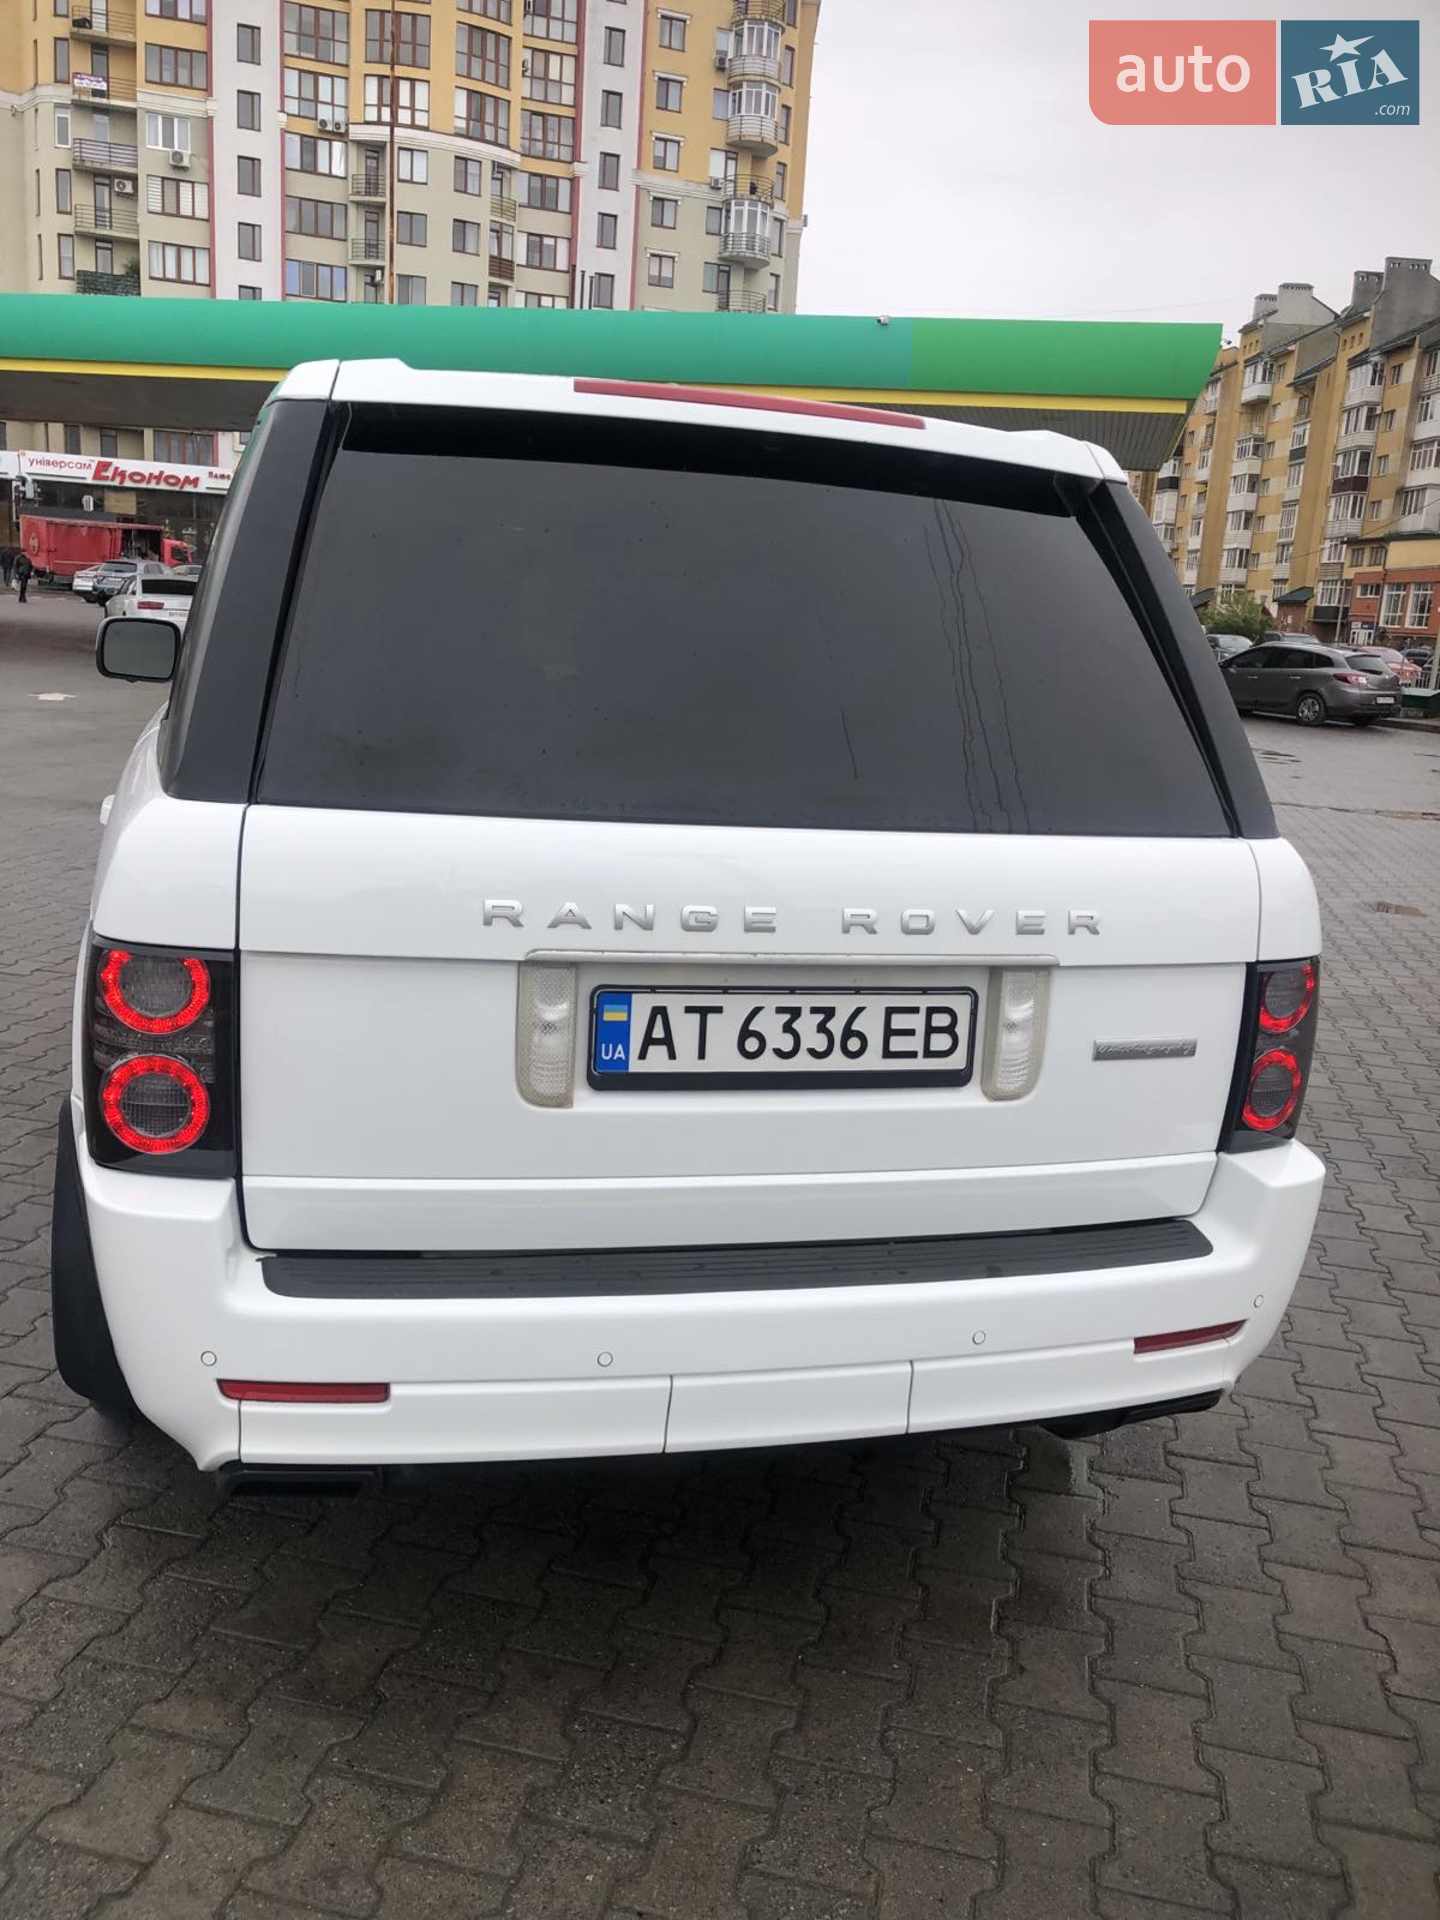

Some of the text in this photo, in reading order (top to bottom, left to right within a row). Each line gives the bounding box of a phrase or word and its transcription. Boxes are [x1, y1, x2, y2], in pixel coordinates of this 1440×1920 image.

[28, 457, 92, 470] універсам
[483, 898, 1101, 935] RANGE ROVER
[637, 1005, 960, 1061] AT 6336 EB
[601, 1043, 626, 1061] UA
